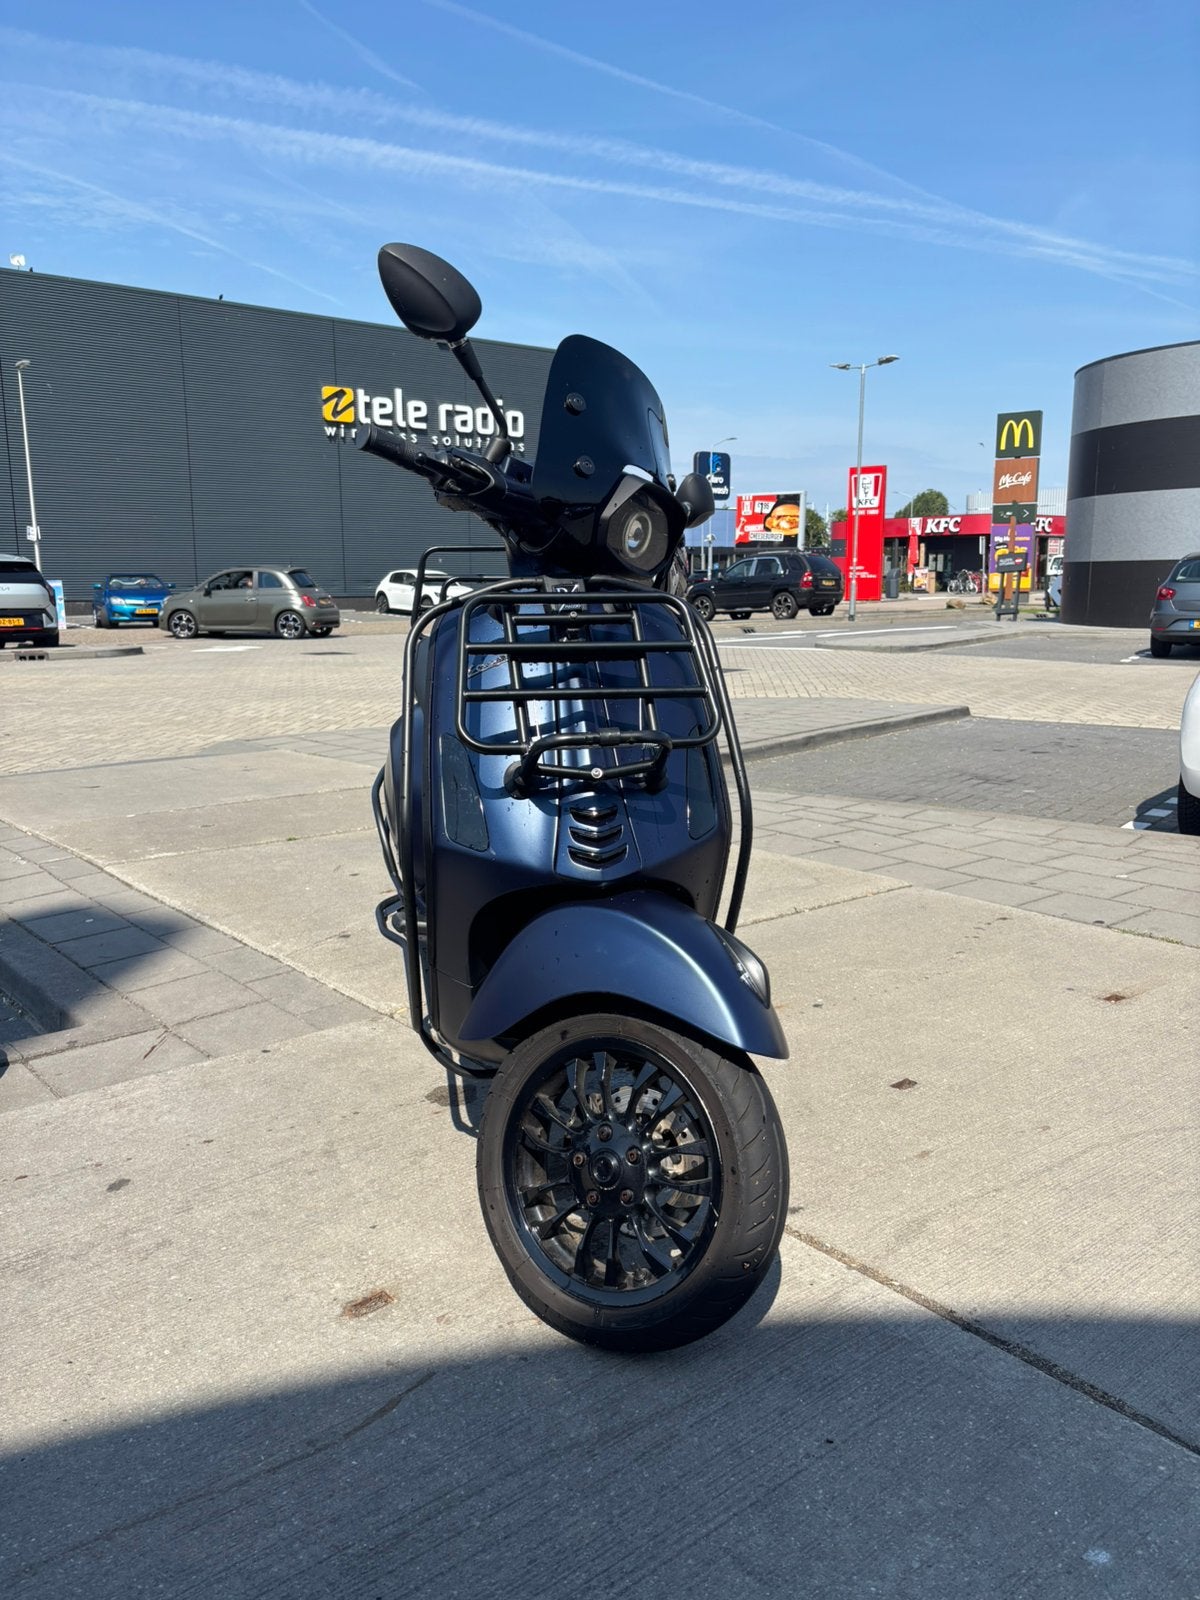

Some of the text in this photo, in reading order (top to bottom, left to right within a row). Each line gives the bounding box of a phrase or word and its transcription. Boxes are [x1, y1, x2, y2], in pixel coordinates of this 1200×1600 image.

[356, 388, 428, 430] tele
[925, 517, 961, 534] KFC
[1035, 517, 1054, 532] FC
